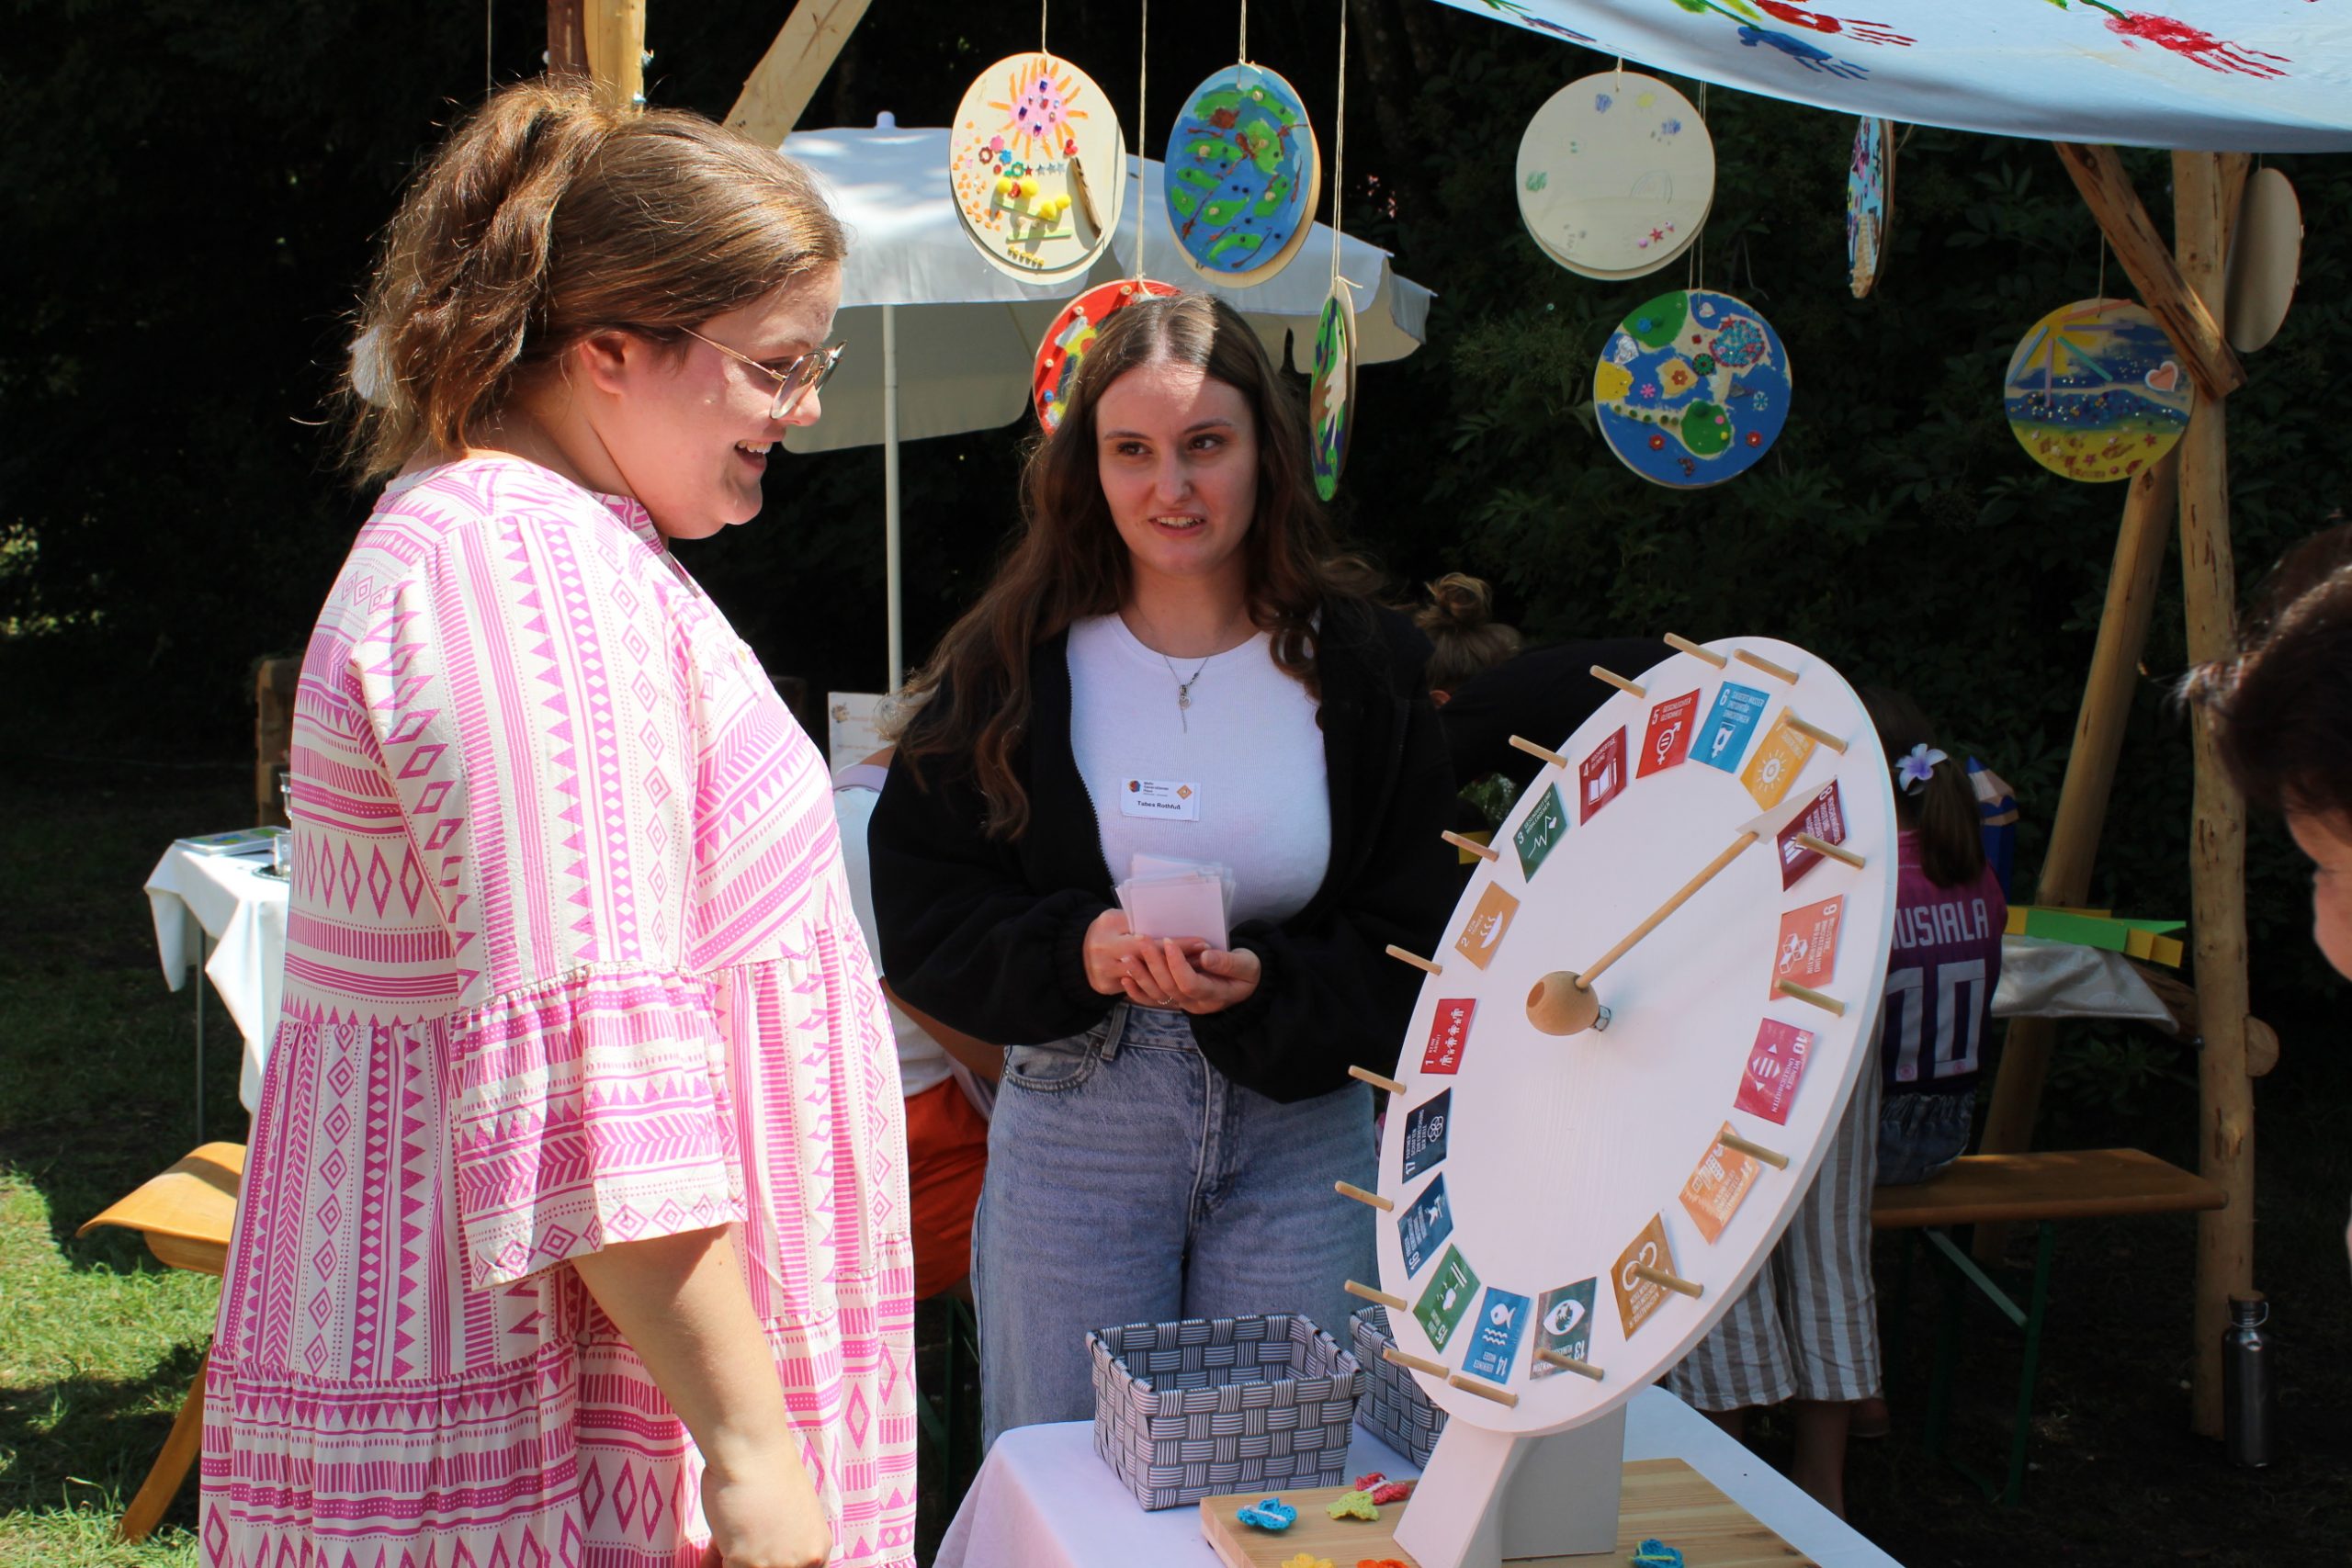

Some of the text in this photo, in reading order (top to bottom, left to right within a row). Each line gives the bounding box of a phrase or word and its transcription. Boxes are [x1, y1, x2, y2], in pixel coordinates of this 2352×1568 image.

[1719, 689, 1731, 706] 6
[1651, 709, 1659, 725] 5
[1582, 763, 1589, 777] 4
[1818, 785, 1834, 801] 8
[1517, 830, 1525, 844] 3
[1823, 903, 1838, 916] 9
[1461, 937, 1470, 948] 2
[1886, 959, 1985, 1082] 10
[1792, 1033, 1810, 1055] 10
[1405, 1162, 1416, 1175] 17
[1408, 1252, 1421, 1270] 16
[1434, 1324, 1449, 1345] 15
[1574, 1340, 1586, 1360] 13
[1496, 1357, 1507, 1377] 14
